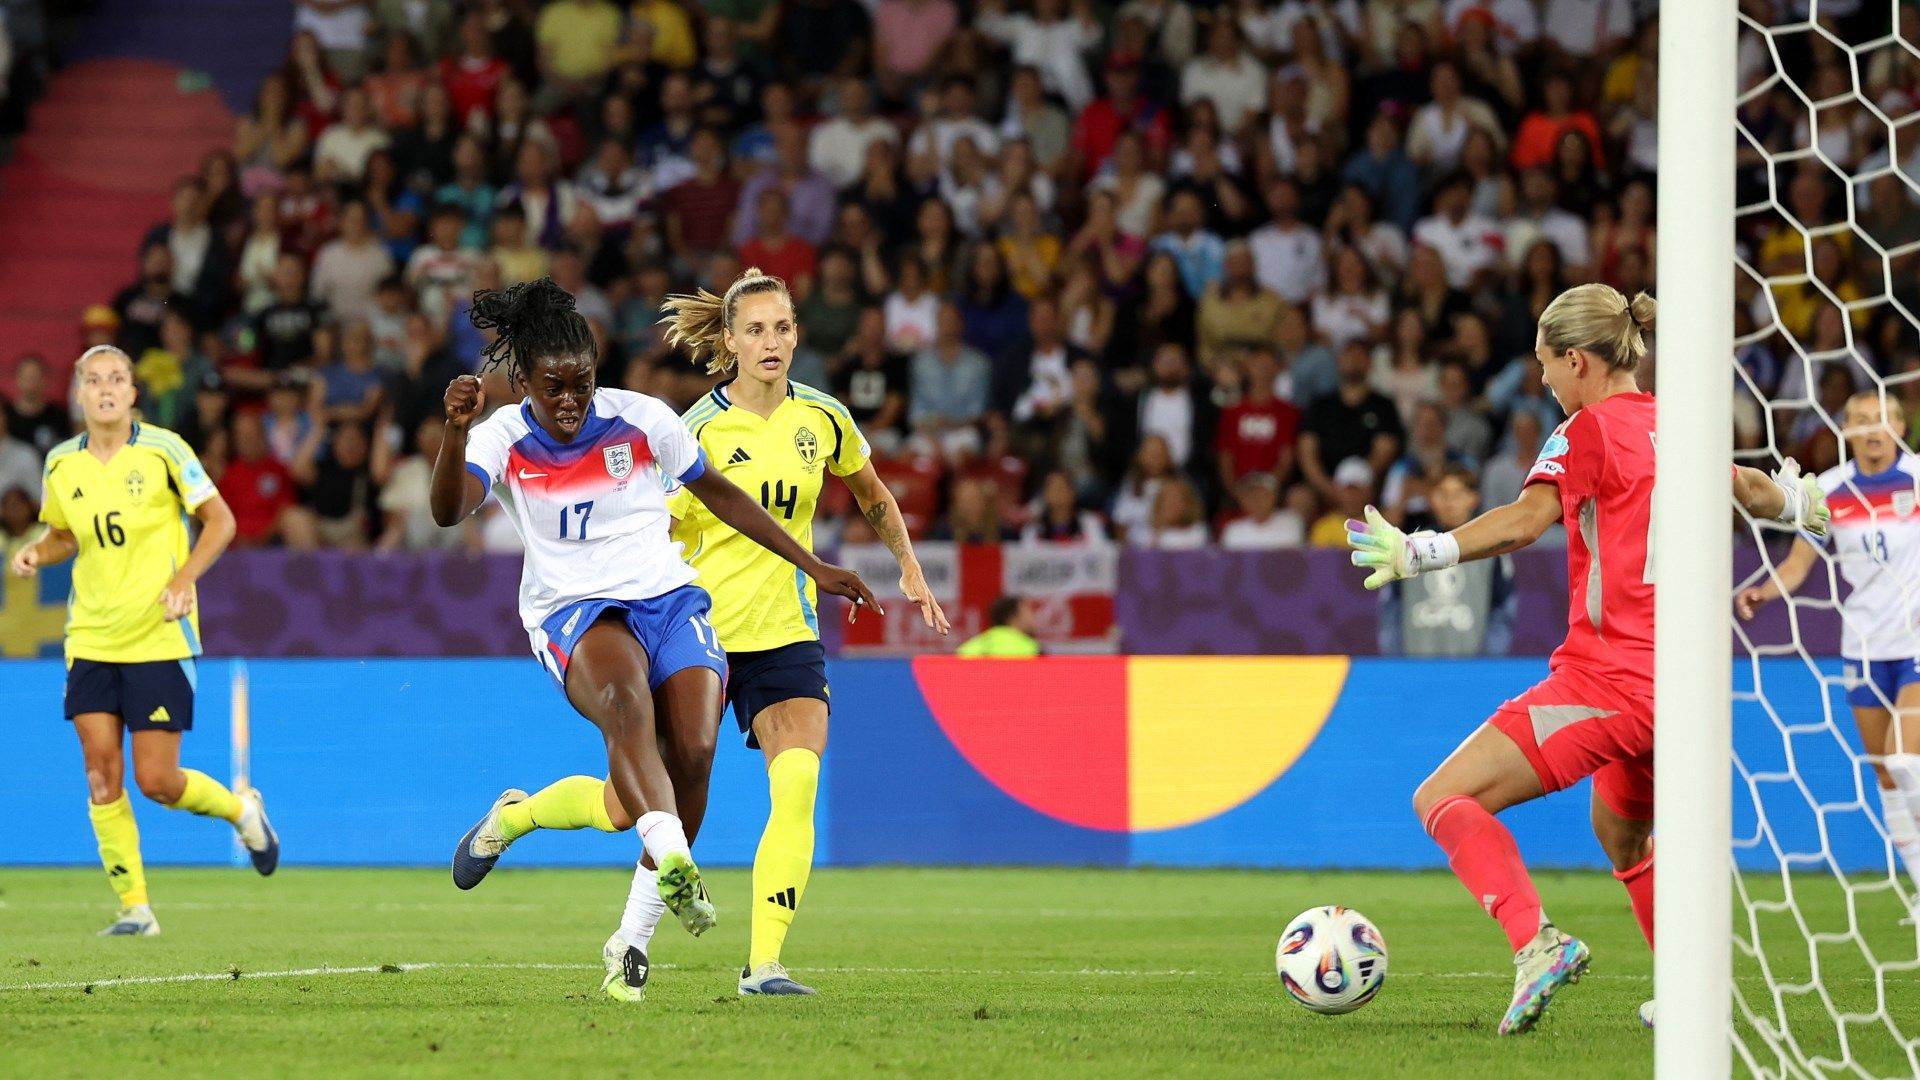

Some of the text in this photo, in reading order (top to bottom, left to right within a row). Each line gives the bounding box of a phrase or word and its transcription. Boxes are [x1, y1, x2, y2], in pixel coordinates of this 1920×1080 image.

[761, 479, 797, 520] 14
[94, 511, 126, 549] 16
[559, 500, 594, 540] 17
